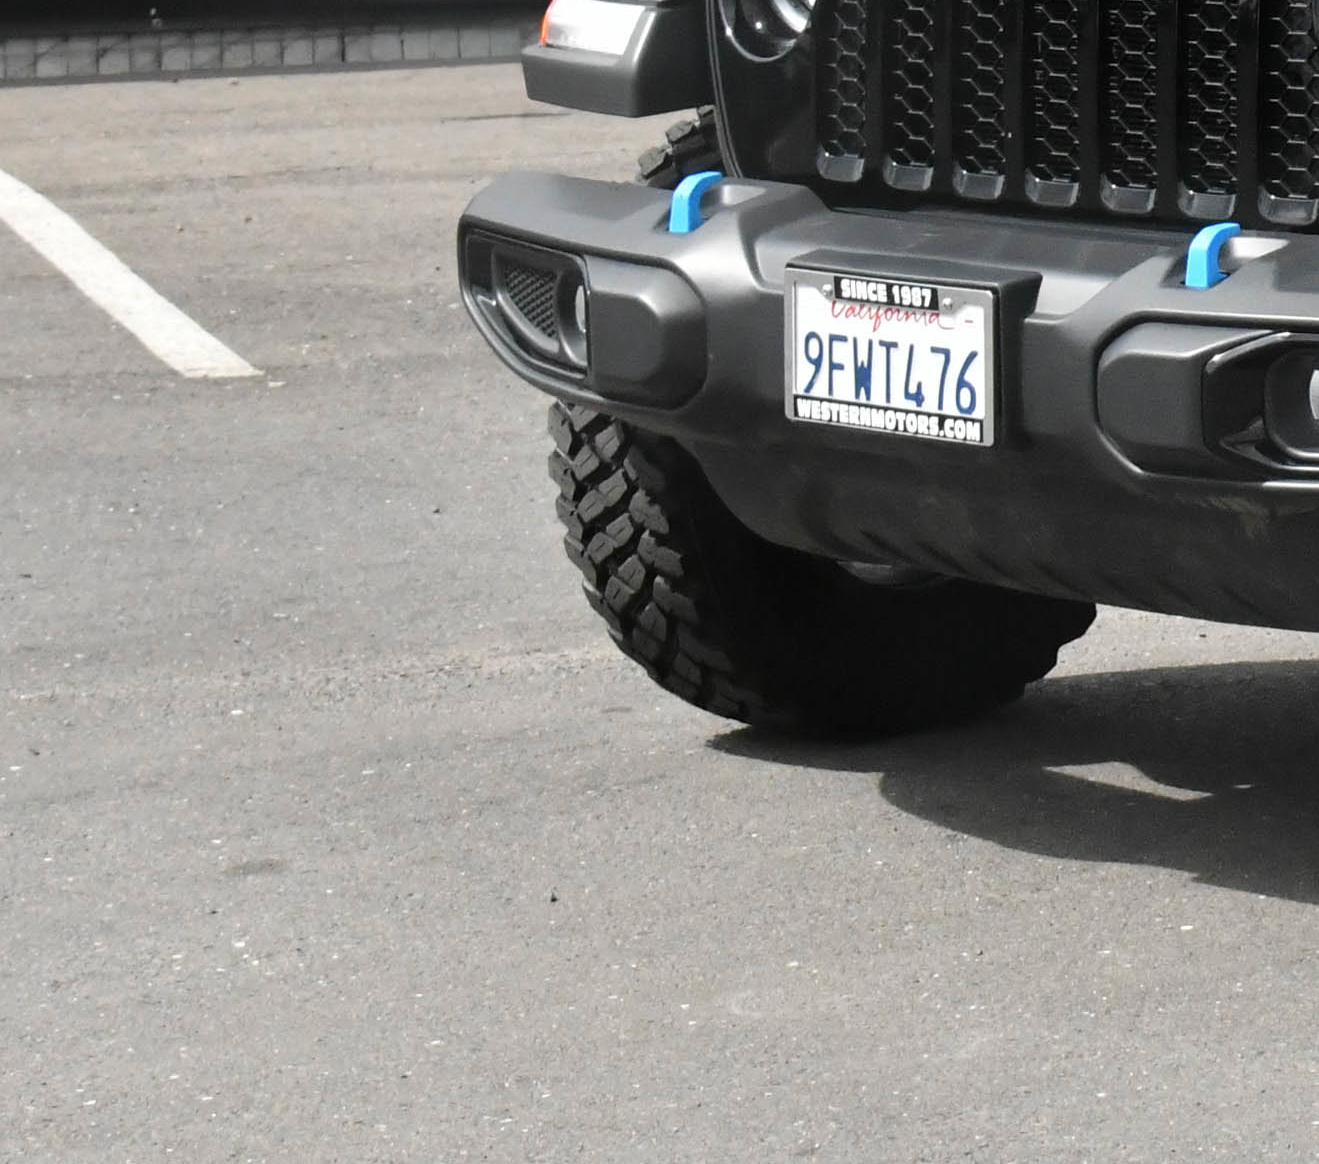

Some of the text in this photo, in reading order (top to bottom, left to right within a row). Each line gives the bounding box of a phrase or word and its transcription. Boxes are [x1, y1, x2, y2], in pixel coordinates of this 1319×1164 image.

[839, 278, 932, 308] SINCE 1987
[803, 331, 978, 415] 9FWT476
[796, 397, 982, 442] WESTERNMOTORS.COM
